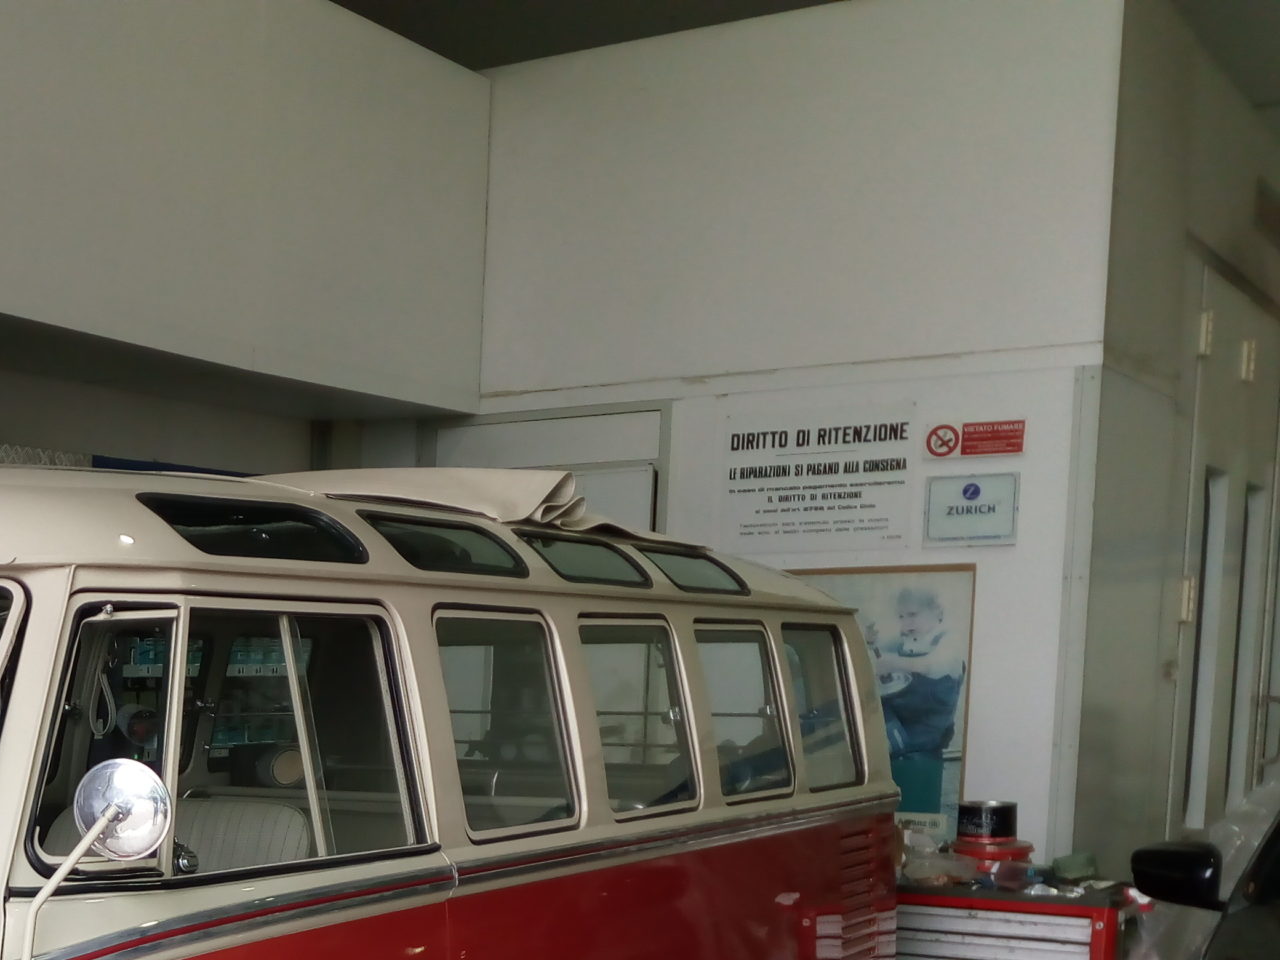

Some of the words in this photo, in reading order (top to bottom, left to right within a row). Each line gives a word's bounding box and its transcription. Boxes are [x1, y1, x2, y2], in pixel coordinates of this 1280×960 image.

[730, 430, 789, 451] DIRITTO
[795, 428, 811, 448] DI
[817, 421, 910, 446] RITENZIONE
[729, 467, 737, 481] LE
[739, 463, 791, 480] RIPARAZIONI
[794, 463, 804, 477] SI
[806, 461, 840, 476] PAGANO
[843, 460, 860, 474] ALLA
[863, 457, 907, 473] CONSEGNA
[778, 493, 806, 503] DIRITTO
[821, 490, 863, 501] RITENZIONE
[945, 503, 996, 516] ZURICH
